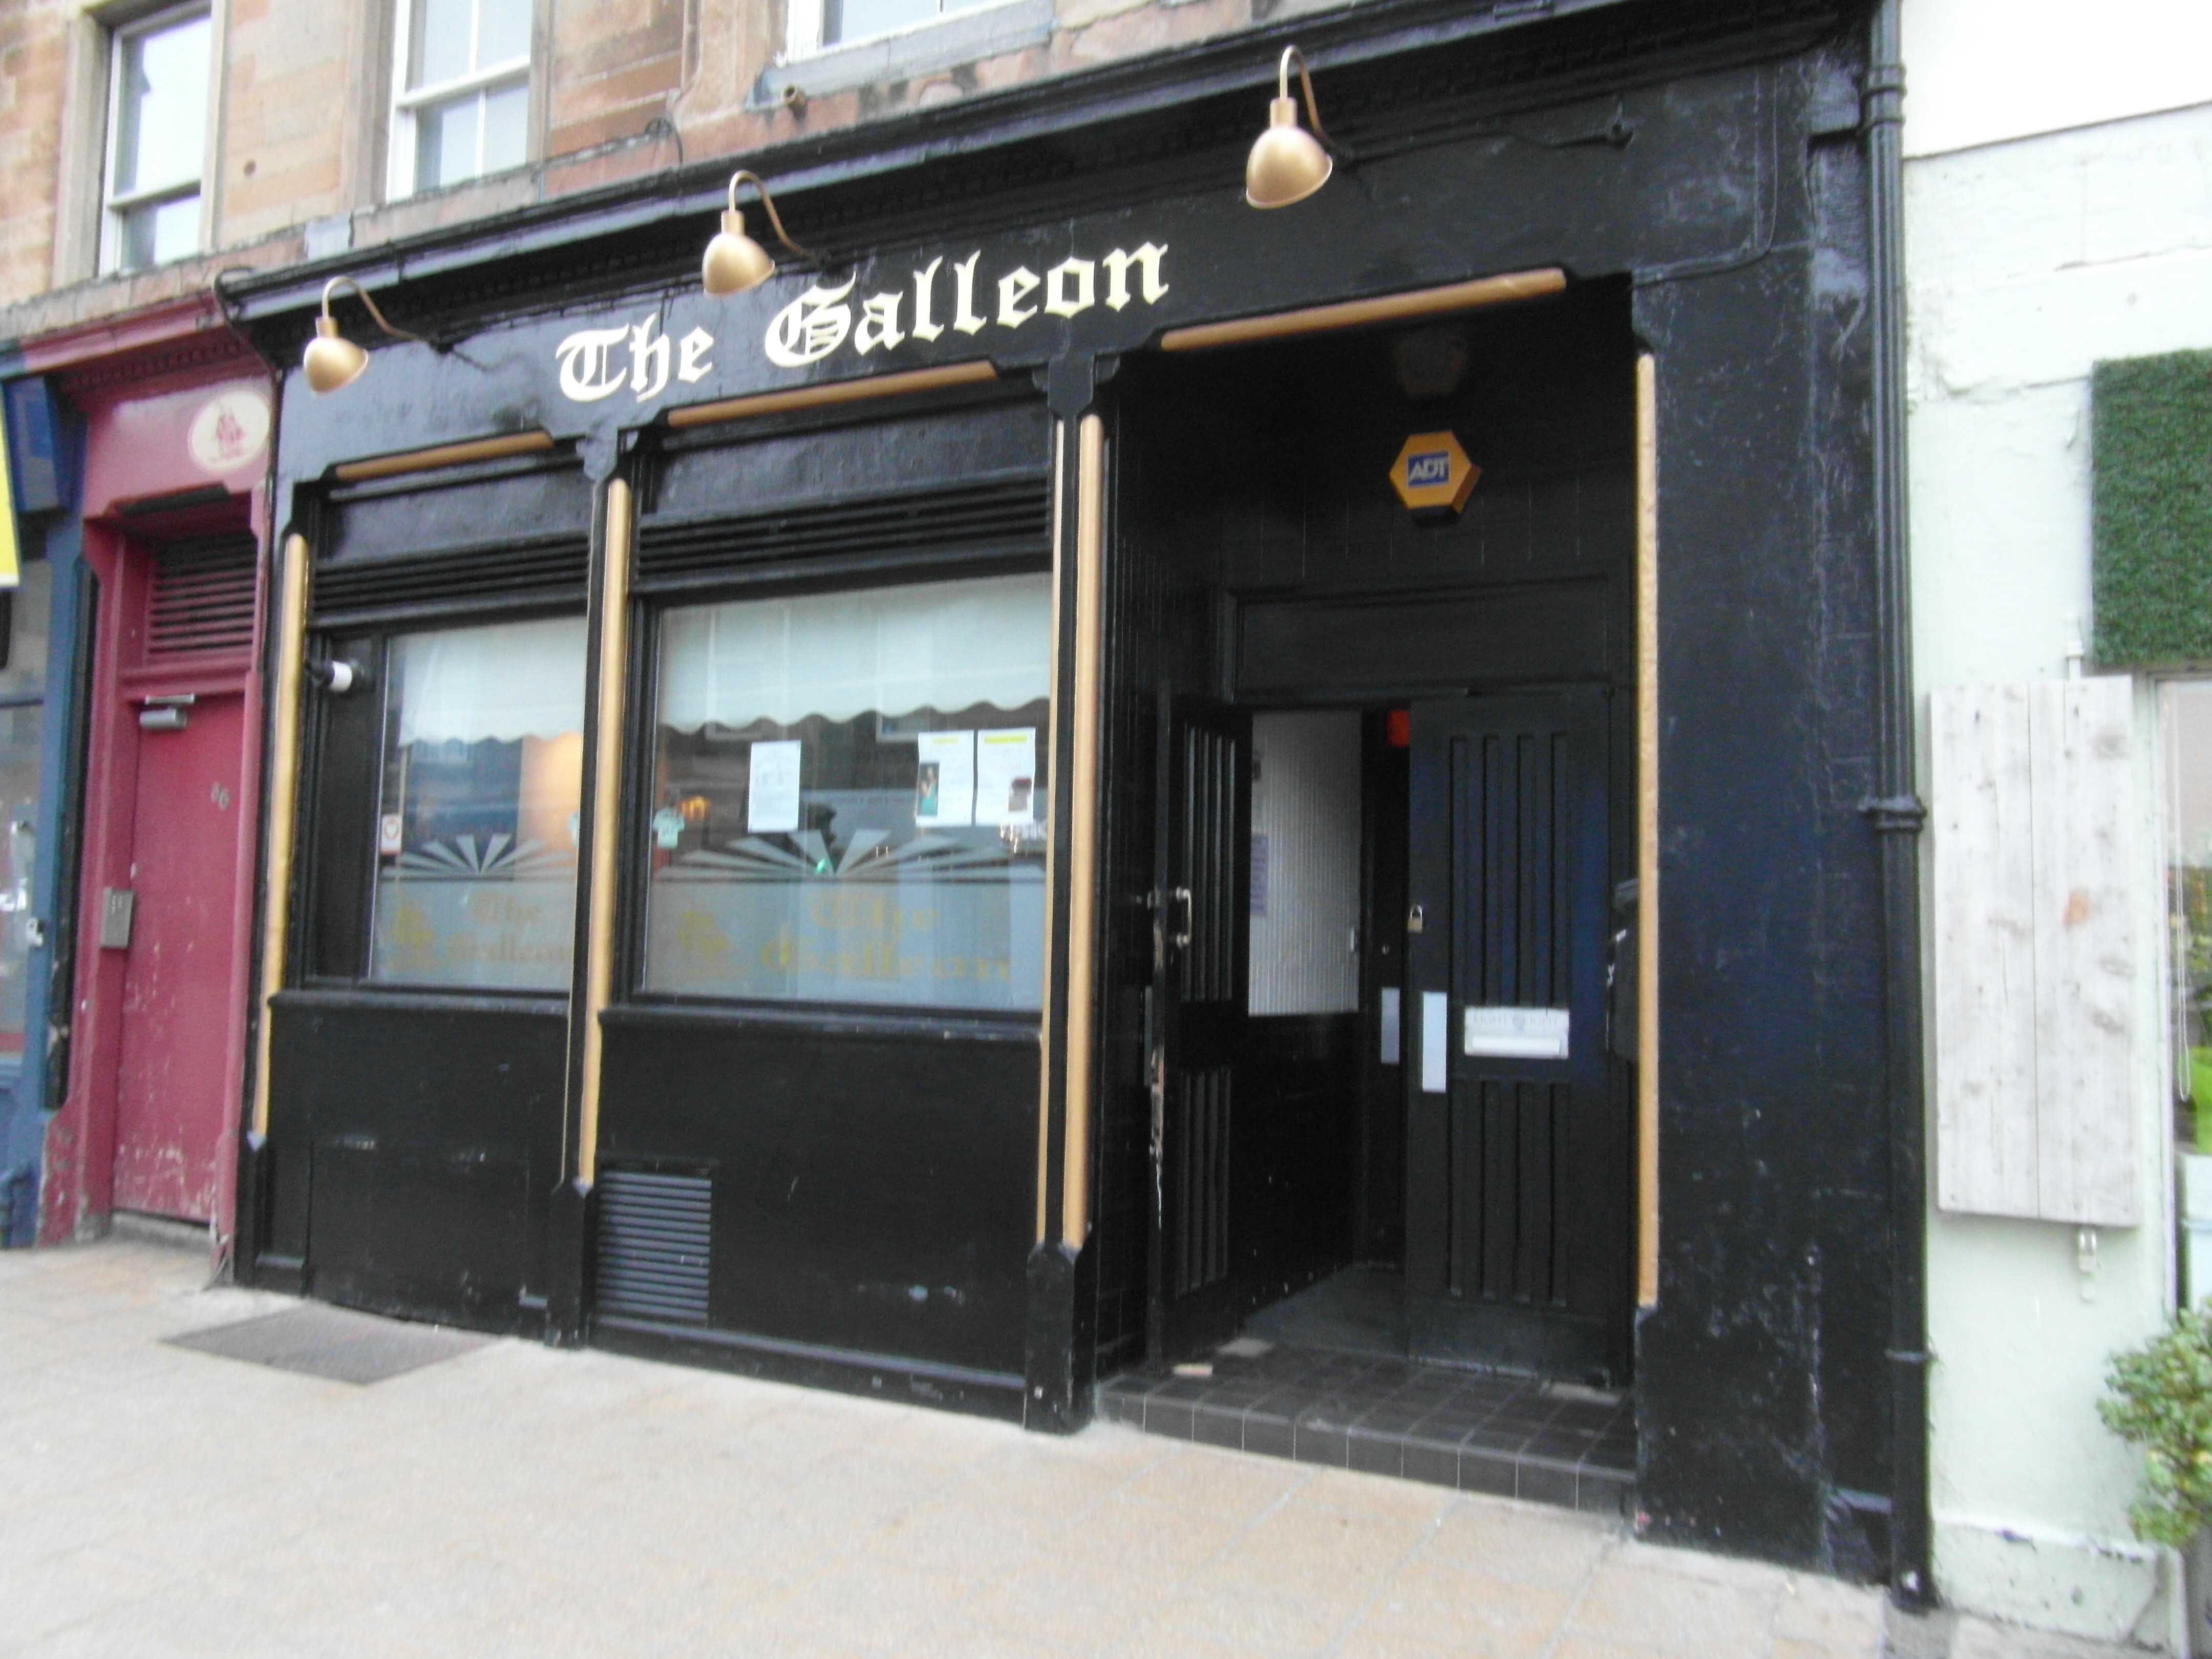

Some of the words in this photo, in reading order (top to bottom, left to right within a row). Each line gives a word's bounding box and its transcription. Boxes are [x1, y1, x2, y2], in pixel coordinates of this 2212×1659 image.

[555, 312, 715, 403] The
[764, 242, 1169, 368] Galleon
[1409, 457, 1449, 483] ADT
